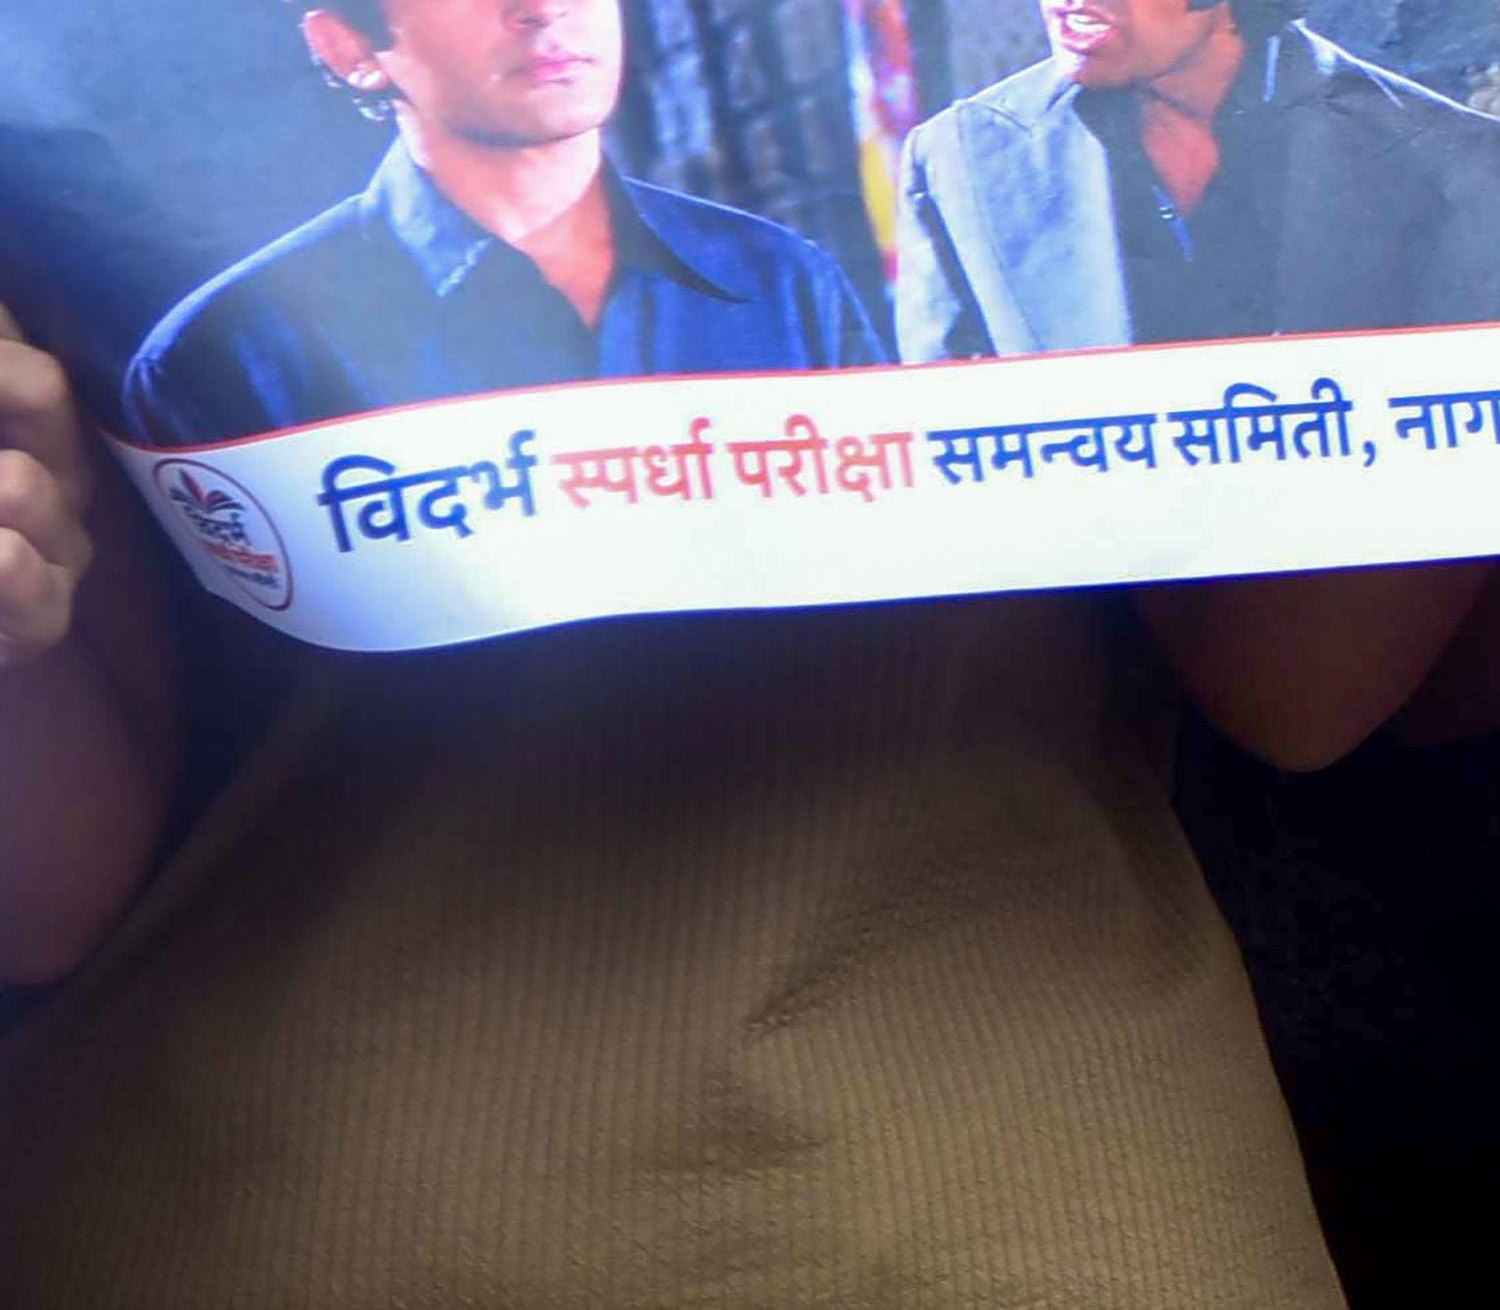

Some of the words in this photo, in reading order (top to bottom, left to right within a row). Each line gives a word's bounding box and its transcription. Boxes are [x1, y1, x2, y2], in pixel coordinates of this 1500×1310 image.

[318, 428, 540, 554] विदर्भ
[550, 416, 714, 510] स्पर्धा
[726, 414, 916, 504] परीक्षा
[928, 412, 1156, 486] समन्वय
[1168, 376, 1378, 468] समिती,
